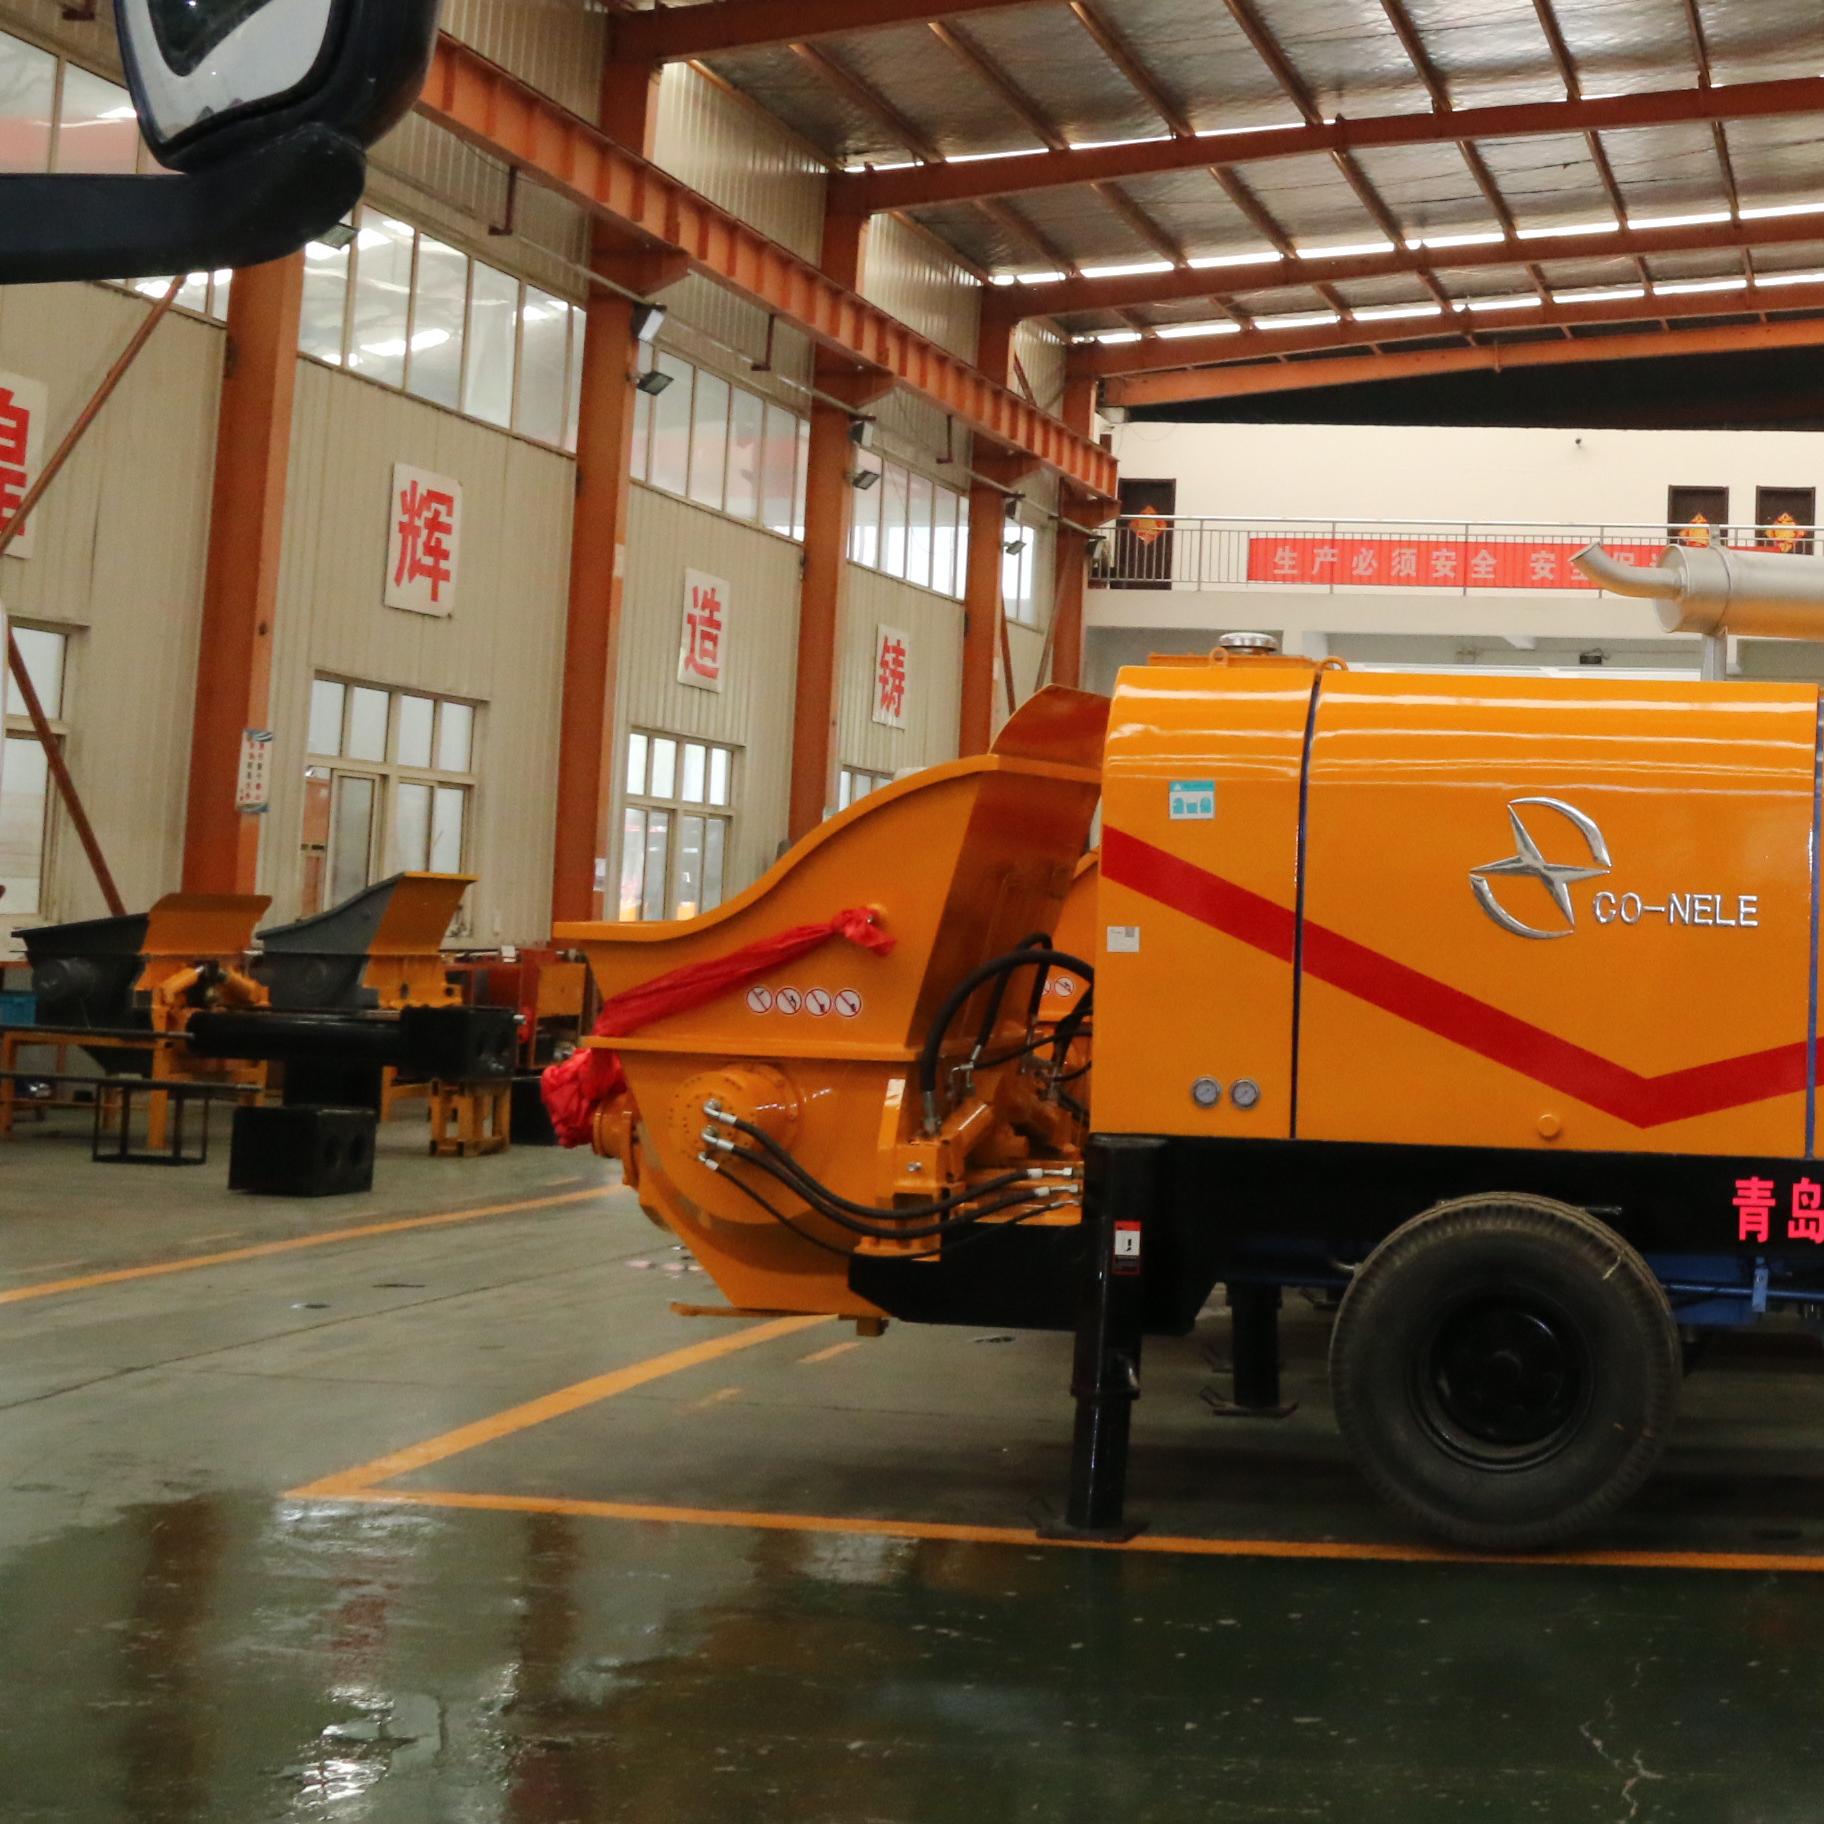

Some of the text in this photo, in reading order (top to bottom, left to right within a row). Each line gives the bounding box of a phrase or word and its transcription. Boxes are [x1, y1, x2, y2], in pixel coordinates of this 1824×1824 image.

[394, 480, 454, 602] 辉
[1273, 546, 1498, 579] 生产必须安全
[684, 585, 722, 680] 造
[878, 635, 906, 718] 铸
[1594, 891, 1759, 927] CO-NELE
